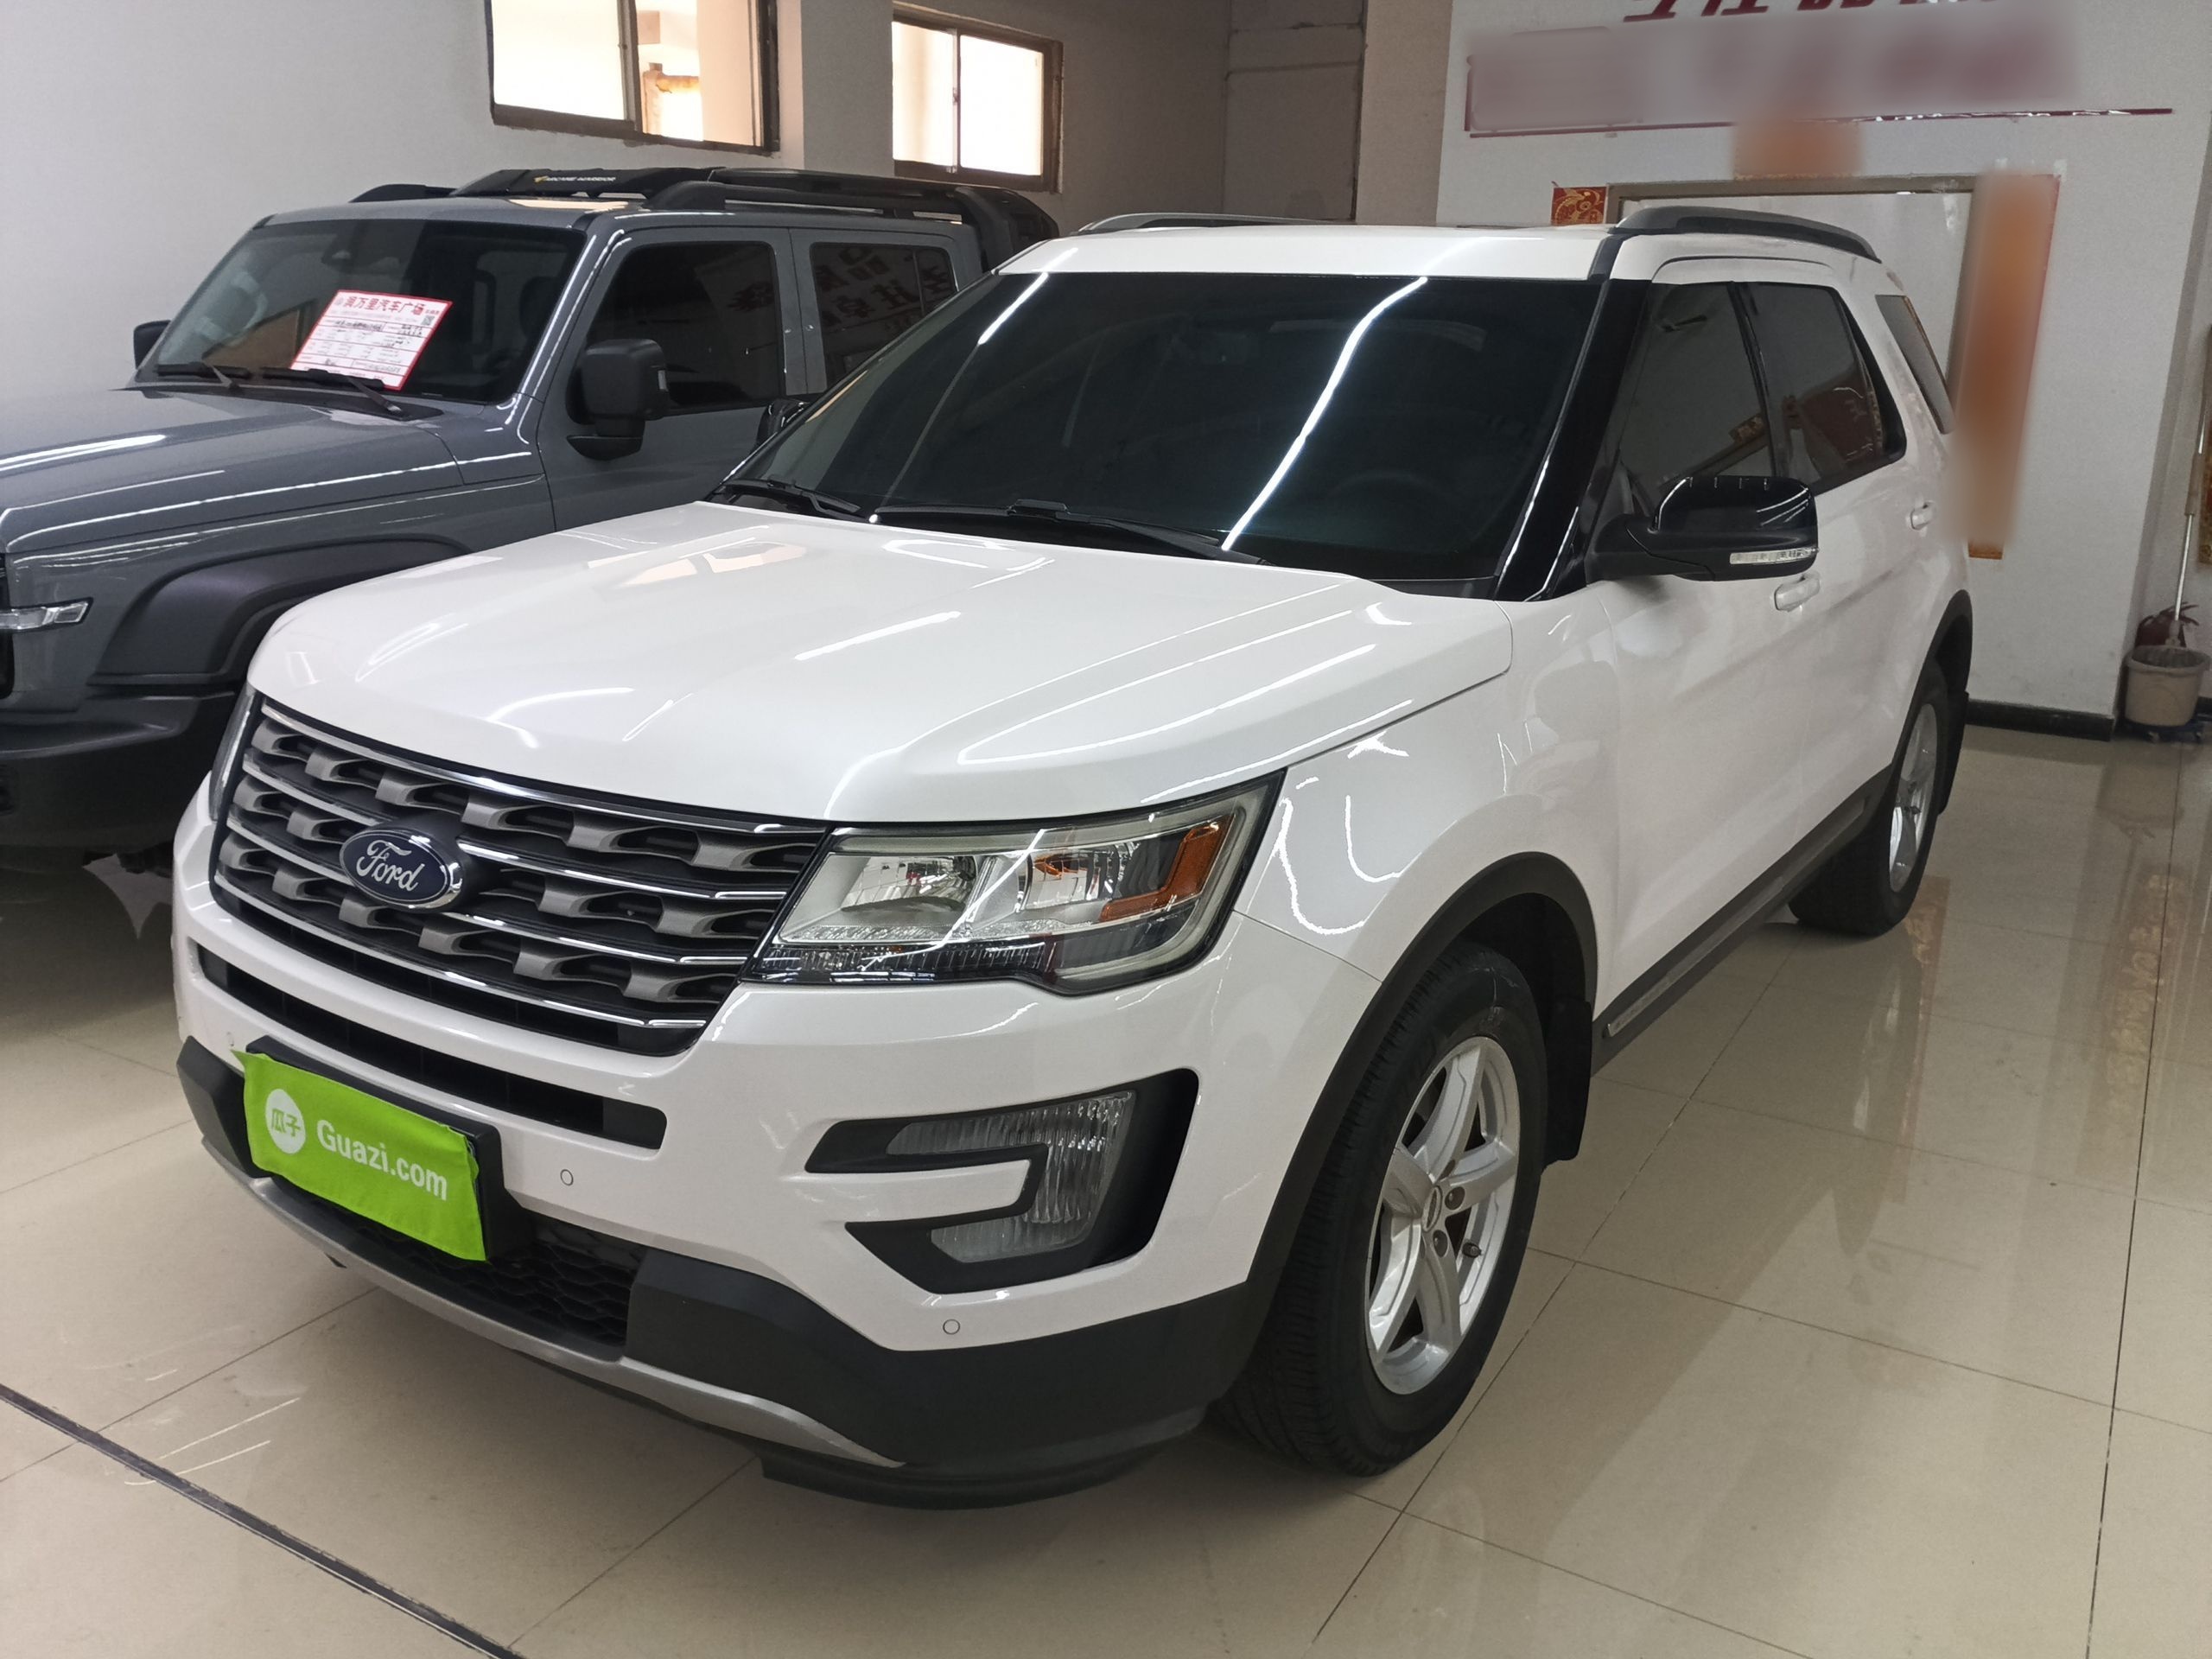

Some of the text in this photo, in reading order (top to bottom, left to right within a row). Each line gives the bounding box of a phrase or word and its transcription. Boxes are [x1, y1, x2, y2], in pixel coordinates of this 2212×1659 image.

[356, 839, 425, 892] Ford
[270, 1108, 302, 1138] 瓜子
[316, 1119, 448, 1201] Guazi.com
